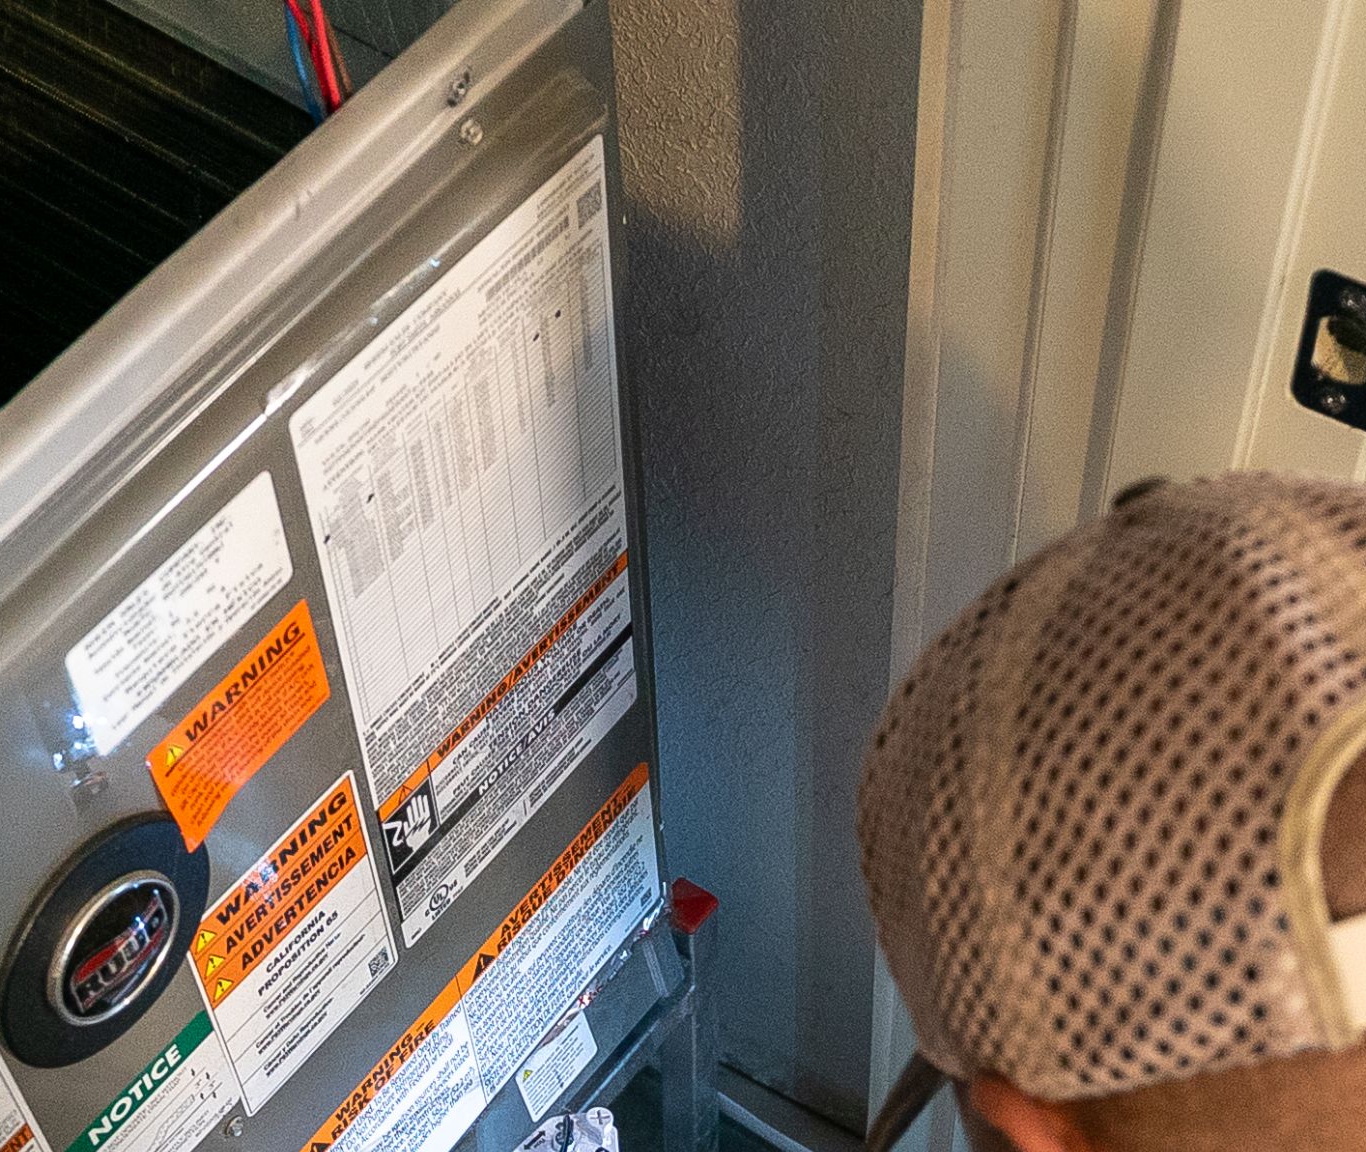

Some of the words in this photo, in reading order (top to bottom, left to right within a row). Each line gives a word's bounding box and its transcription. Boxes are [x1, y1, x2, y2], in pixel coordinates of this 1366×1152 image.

[184, 618, 300, 745] WARNING
[437, 562, 618, 760] WARNING/AVERTISSEMENT
[478, 707, 555, 795] NOTICE/AVIS
[488, 707, 525, 751] TENSION
[216, 785, 347, 928] WARNING
[223, 812, 354, 954] AVERTISSEMENT
[239, 841, 356, 971] ADVERTENCIA
[496, 883, 551, 953] RISQUE
[554, 784, 636, 886] D'INCENDIE
[498, 793, 619, 938] AVERTISSEMENT
[73, 898, 167, 1010] RUUD
[257, 923, 324, 997] PROPOSITION
[325, 908, 338, 927] 65
[263, 992, 281, 1014] Cancer
[281, 981, 292, 995] and
[292, 946, 325, 985] Reproductive
[265, 907, 325, 975] CALIFORNIA
[463, 971, 488, 1004] Contient
[255, 1028, 273, 1049] Cancer
[273, 1021, 280, 1031] et
[280, 998, 302, 1024] Troubles
[302, 990, 309, 1001] de
[373, 1094, 382, 1105] To
[380, 1084, 390, 1098] Be
[389, 1053, 418, 1089] Repaired
[415, 1037, 432, 1059] Only
[430, 1028, 440, 1043] By
[439, 1003, 461, 1032] Trained
[87, 1042, 182, 1147] NOTICE
[330, 1092, 371, 1140] RISK
[373, 1063, 396, 1092] OF
[398, 1018, 435, 1064] FIRE
[335, 1031, 413, 1121] WARNING
[344, 1135, 357, 1150] Do
[355, 1121, 368, 1138] Not
[367, 1090, 395, 1125] Puncture
[394, 1053, 428, 1095] Refrigerant
[359, 1102, 395, 1145] Accordance
[394, 1086, 409, 1105] with
[407, 1060, 431, 1089] Federal
[437, 1034, 454, 1056] Local
[381, 1128, 392, 1142] be
[390, 1102, 415, 1133] ignition
[414, 1079, 436, 1105] sources
[435, 1061, 450, 1080] shall
[449, 1048, 460, 1065] not
[459, 1038, 469, 1053] be
[393, 1120, 409, 1139] than
[431, 1067, 453, 1095] devices
[453, 1049, 469, 1071] listed
[430, 1105, 450, 1130] higher
[449, 1089, 463, 1107] than
[463, 1079, 473, 1092] sea
[404, 1122, 416, 1137] See
